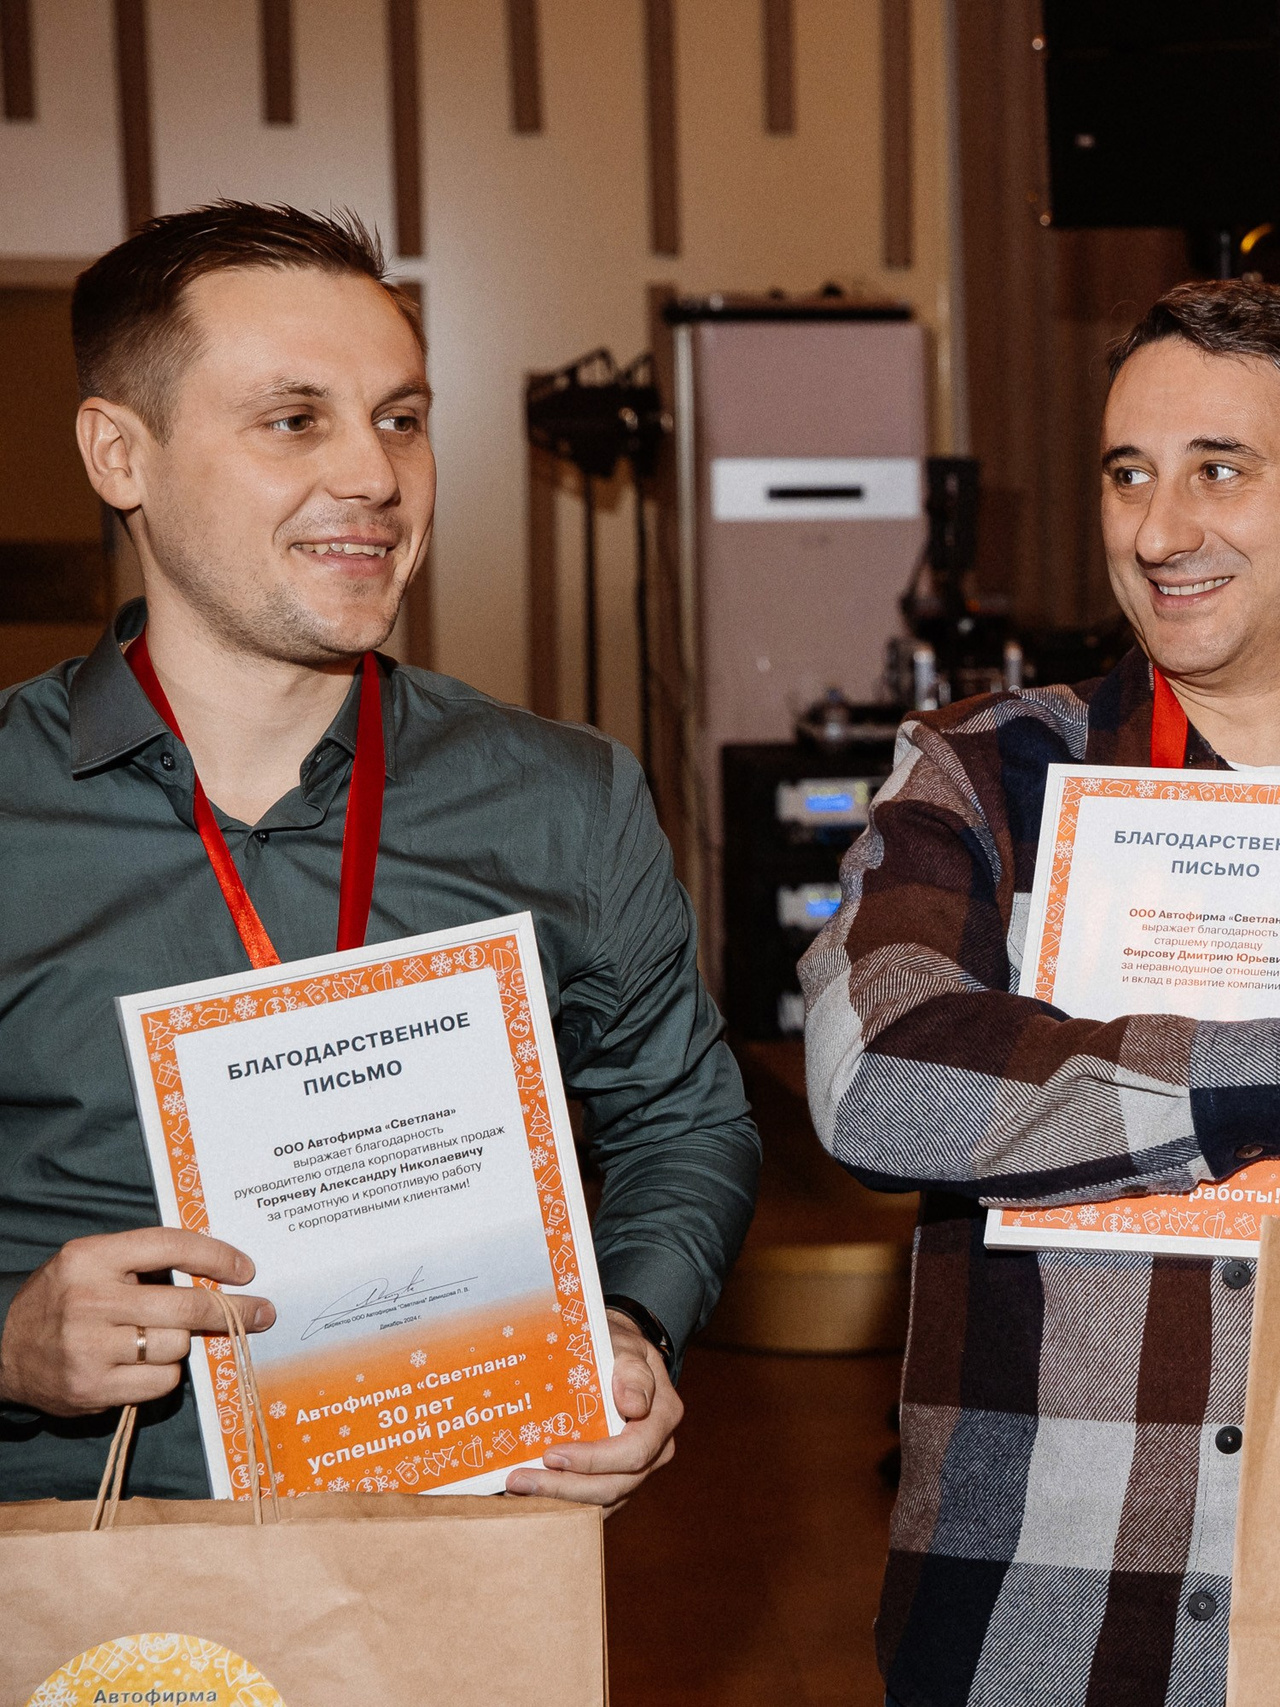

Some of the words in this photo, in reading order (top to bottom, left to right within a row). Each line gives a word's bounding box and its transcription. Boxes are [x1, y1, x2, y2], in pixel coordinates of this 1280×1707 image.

[1171, 860, 1260, 878] ПИСЬМО
[1129, 909, 1156, 918] ООО
[1159, 910, 1226, 922] Автофирма
[1142, 923, 1195, 933] выражает
[1198, 925, 1278, 937] благодарность
[1123, 947, 1175, 959] Фирсову
[1177, 950, 1233, 961] Дмитрию
[1154, 936, 1208, 948] старшему
[1211, 940, 1262, 951] продавцу
[1121, 962, 1133, 970] за
[1136, 963, 1223, 974] неравнодушное
[1132, 977, 1163, 985] вклад
[1175, 979, 1225, 987] развитие
[228, 1012, 470, 1080] БЛАГОДАРСТВЕННОЕ
[303, 1060, 402, 1095] ПИСЬМО
[273, 1142, 304, 1157] ООО
[307, 1124, 382, 1150] Автофирма
[385, 1108, 456, 1130] «Светлана»
[293, 1147, 352, 1169] выражает
[355, 1125, 443, 1154] благодарность
[234, 1170, 321, 1200] руководителю
[324, 1159, 365, 1177] отдела
[368, 1138, 458, 1166] корпоративных
[461, 1125, 505, 1146] продаж
[257, 1187, 316, 1208] Горячеву
[320, 1167, 397, 1193] Александру
[400, 1146, 484, 1174] Николаевичу
[267, 1210, 281, 1222] за
[284, 1194, 349, 1218] грамотную
[352, 1191, 360, 1200] и
[362, 1172, 439, 1198] кропотливую
[442, 1161, 482, 1183] работу
[288, 1223, 295, 1232] с
[298, 1198, 400, 1231] корпоративными
[403, 1179, 470, 1203] клиентами!
[1189, 1183, 1280, 1203] работы!
[324, 1319, 351, 1329] Директор
[366, 1306, 396, 1318] Автофирма
[429, 1290, 456, 1302] Демидова
[380, 1320, 403, 1330] Декабрь
[404, 1316, 417, 1324] 2024
[296, 1384, 412, 1425] Автофирма
[417, 1353, 527, 1390] «Светлана»
[378, 1406, 408, 1428] 30
[414, 1396, 454, 1419] лет
[307, 1424, 431, 1474] успешной
[437, 1393, 532, 1438] работы!
[93, 1689, 217, 1705] Автофирма
